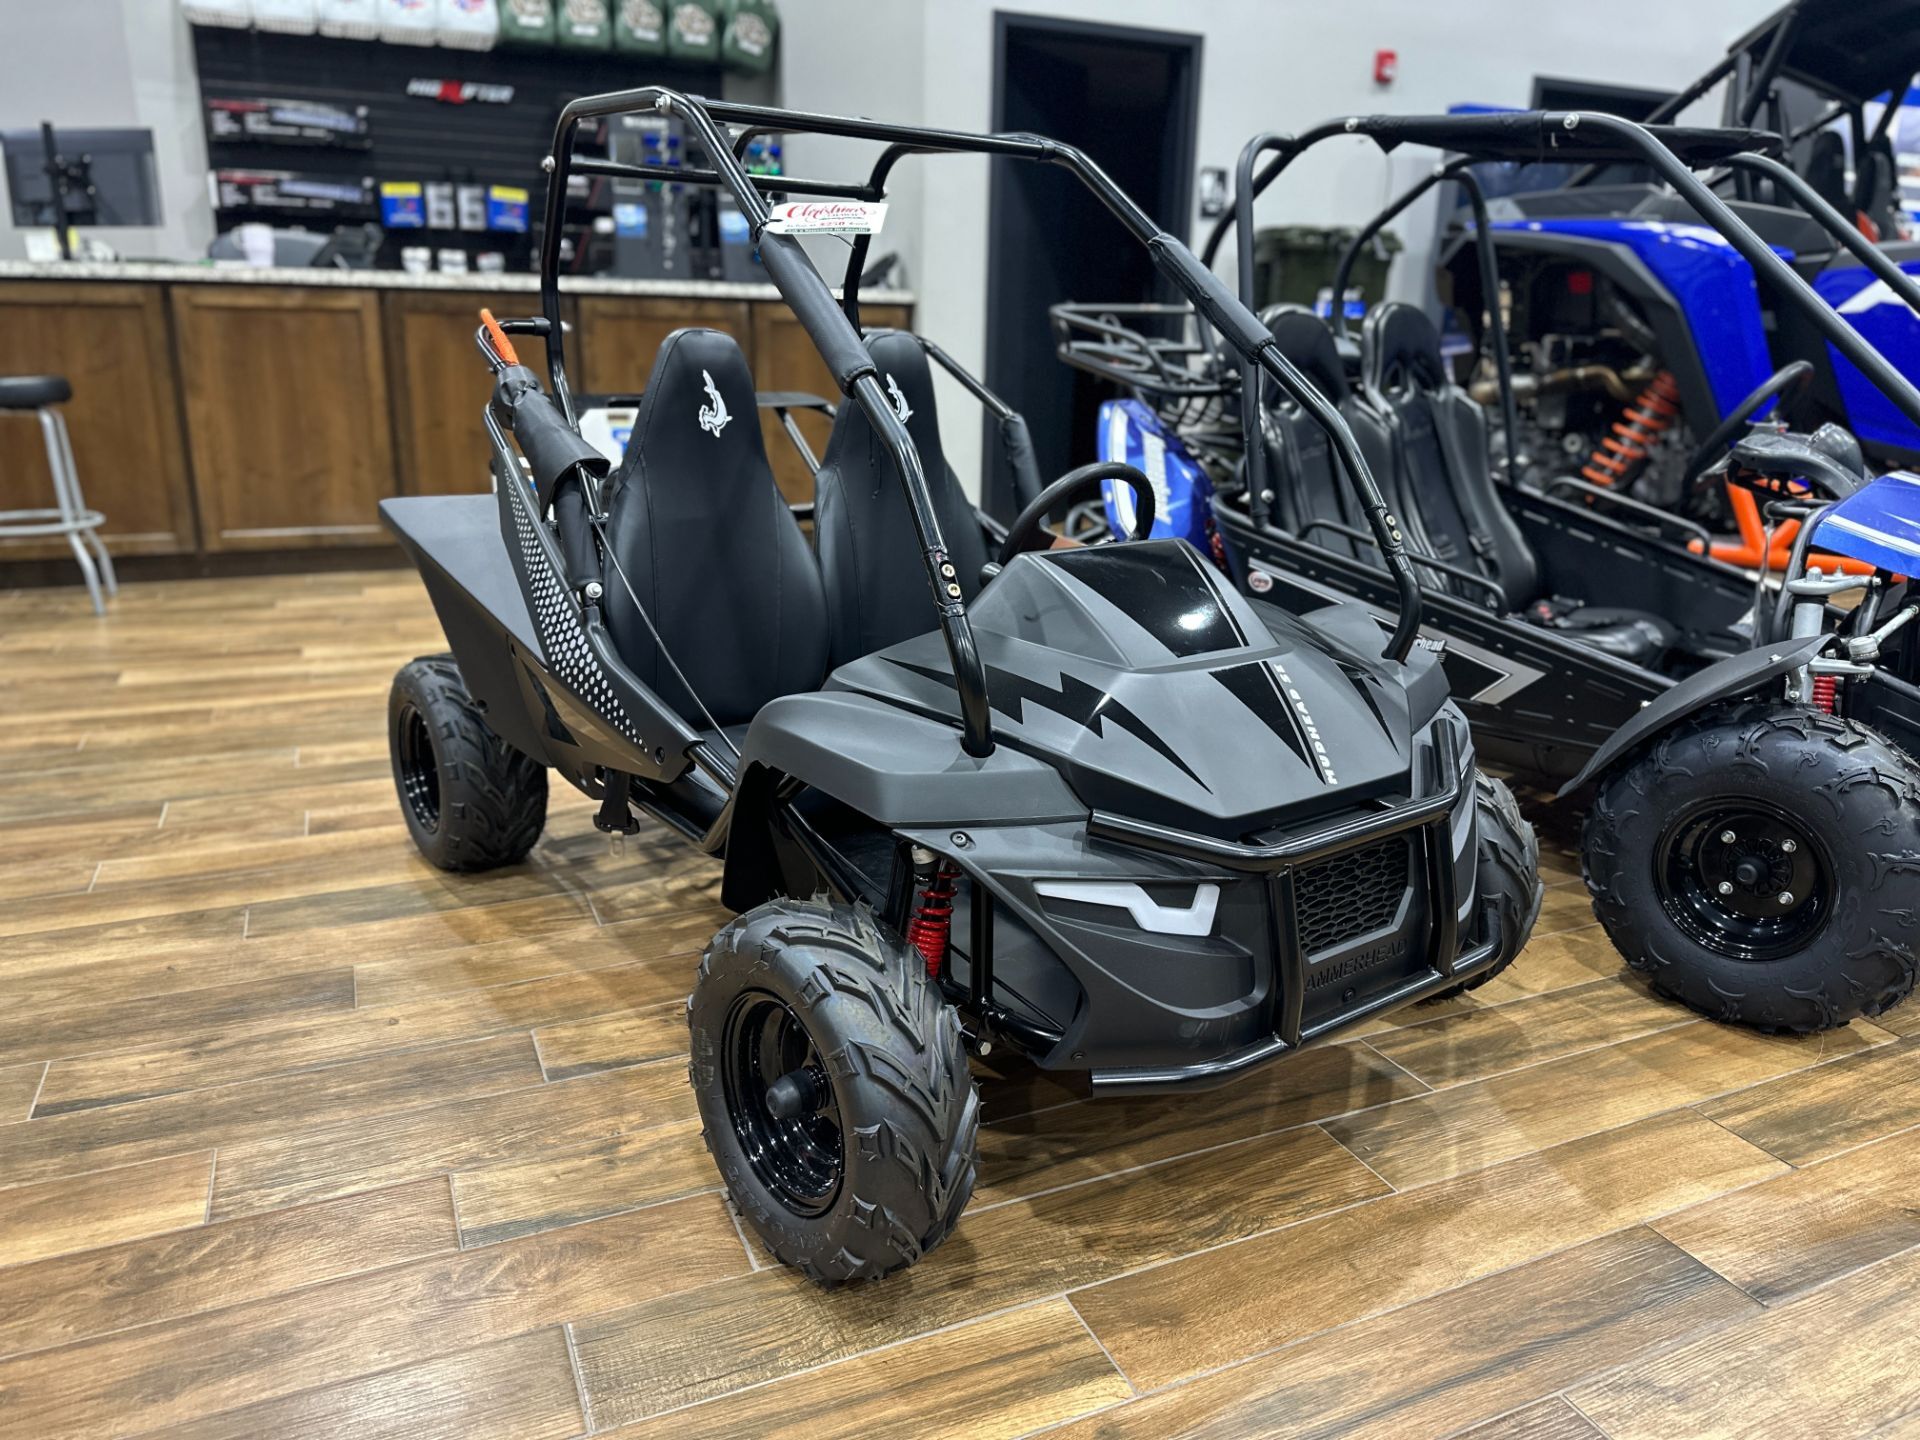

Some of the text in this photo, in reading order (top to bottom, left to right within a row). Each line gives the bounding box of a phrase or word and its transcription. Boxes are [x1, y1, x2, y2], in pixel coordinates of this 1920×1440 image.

[1273, 663, 1338, 785] MUDHEAD SE
[1303, 939, 1408, 993] AMMERHEAD
